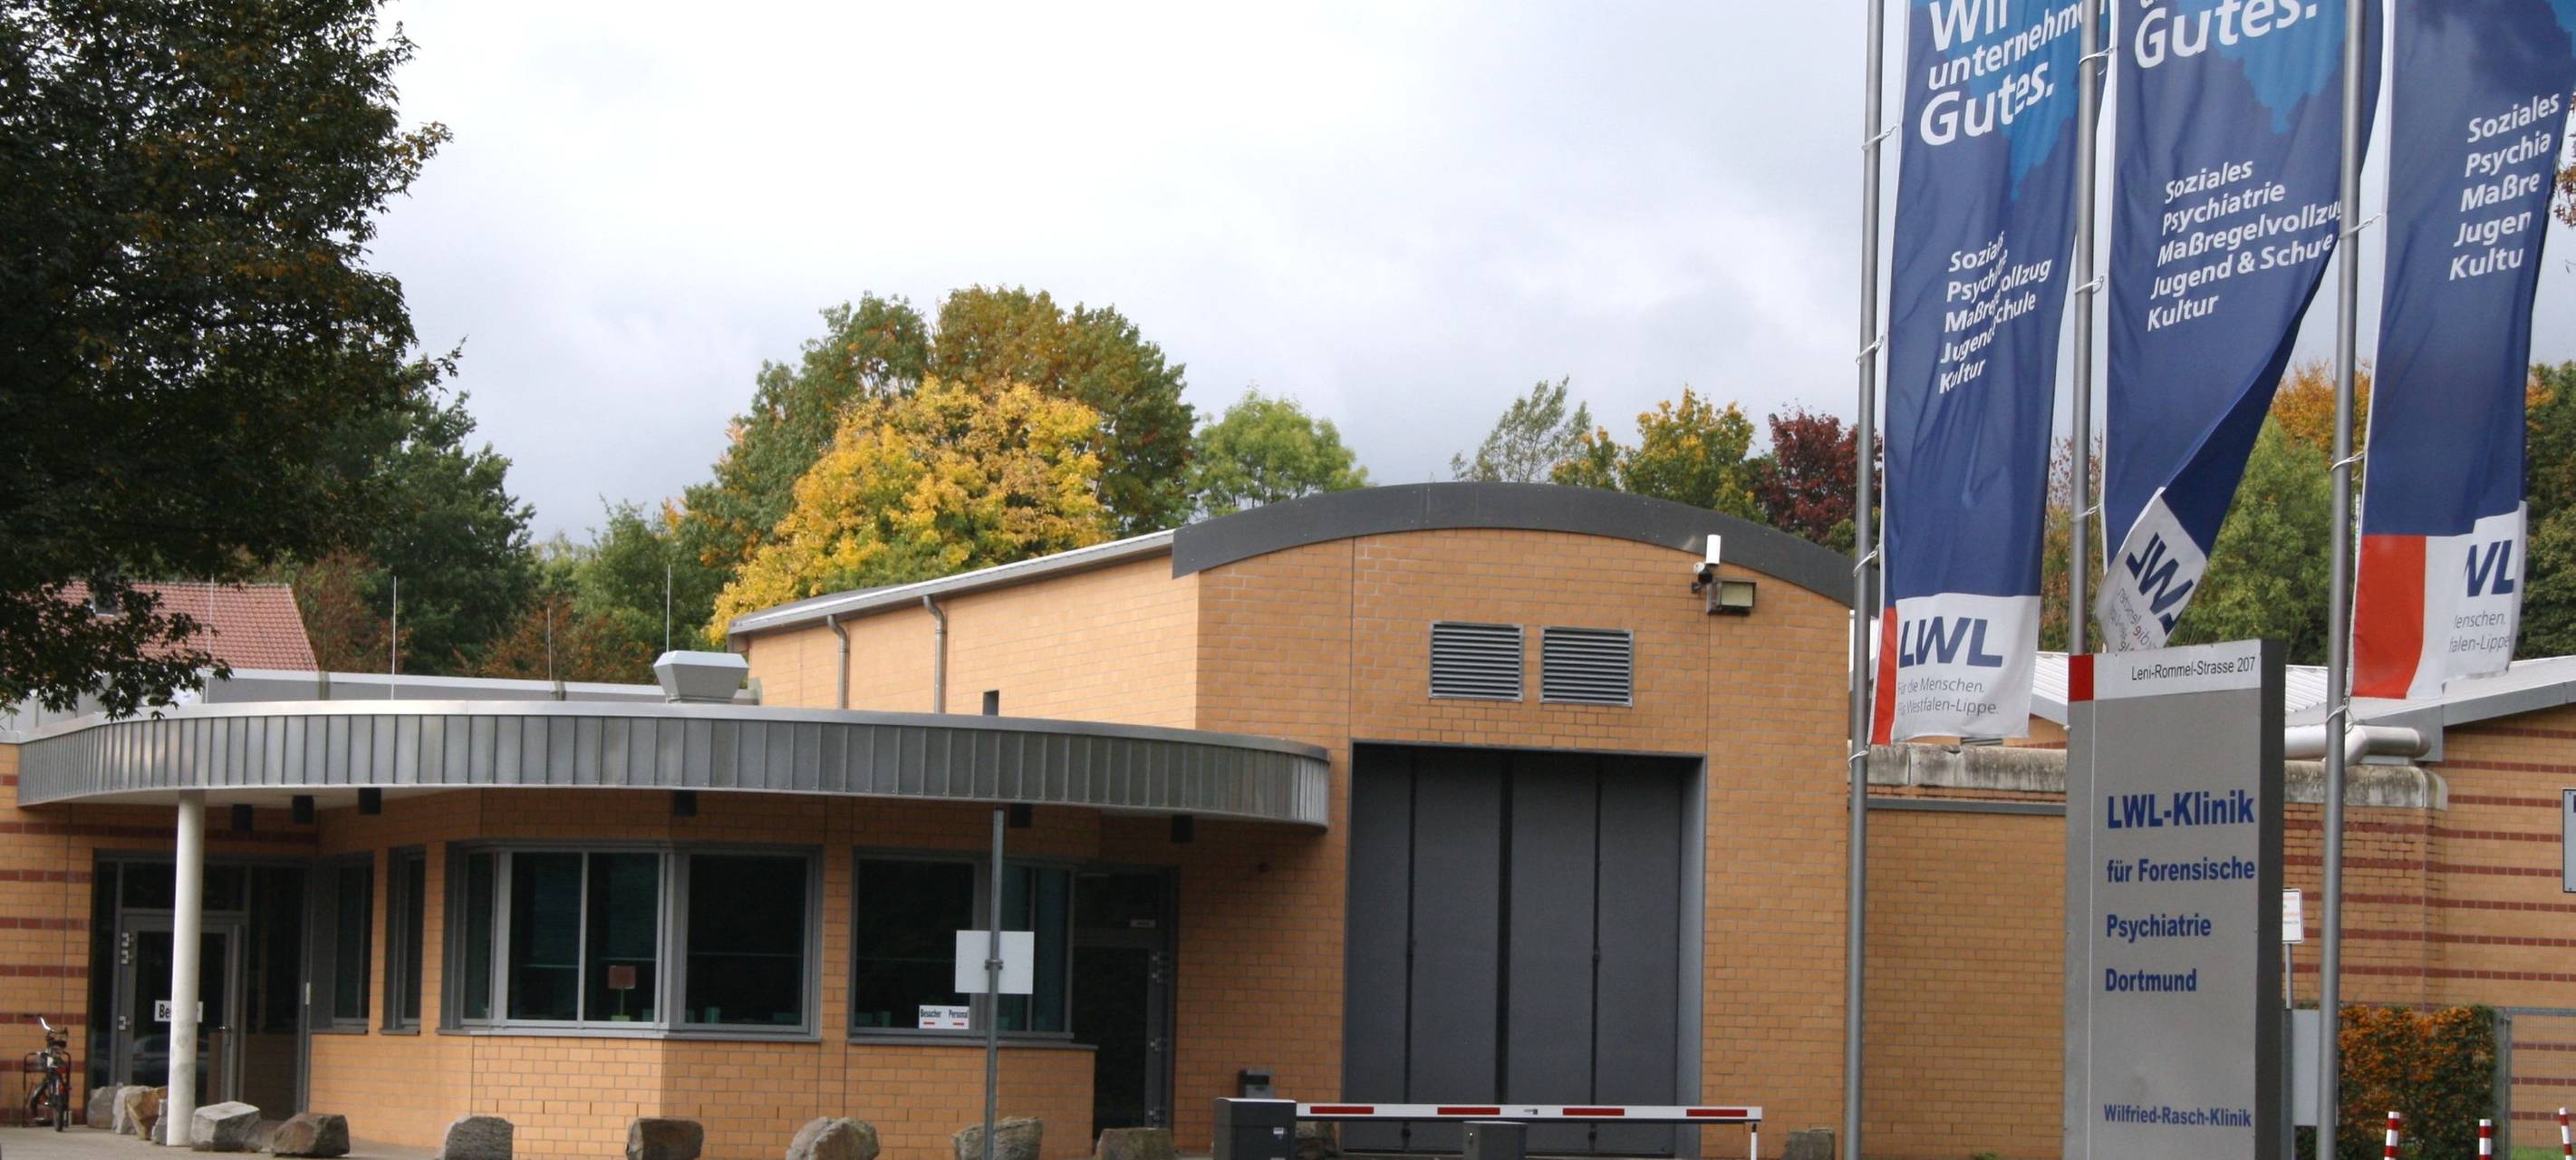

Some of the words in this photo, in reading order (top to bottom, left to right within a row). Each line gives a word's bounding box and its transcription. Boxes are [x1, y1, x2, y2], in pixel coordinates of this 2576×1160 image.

[1929, 0, 2008, 52] Wir
[2135, 0, 2318, 69] Gutes.
[1920, 62, 2054, 146] Gutes.
[2467, 92, 2560, 143] Soziales
[2165, 160, 2253, 204] Soziales
[2162, 181, 2286, 236] Psychiatrie
[2150, 253, 2233, 300] Jugend
[2237, 250, 2255, 276] &
[2147, 295, 2219, 332] Kultur
[1939, 359, 1986, 394] Kultur
[1899, 616, 2003, 668] LWL
[1920, 676, 1984, 693] Menschen.
[2131, 662, 2233, 681] Leni-Rommel-Strasse
[2237, 656, 2255, 673] 207
[2108, 789, 2254, 828] LWL-Klinik
[2107, 859, 2132, 883] für
[2138, 856, 2255, 882] Forensische
[2106, 913, 2212, 943] Psychiatrie
[2105, 968, 2196, 991] Dortmund
[2103, 1104, 2252, 1127] Wilfried-Rasch-Klinik
